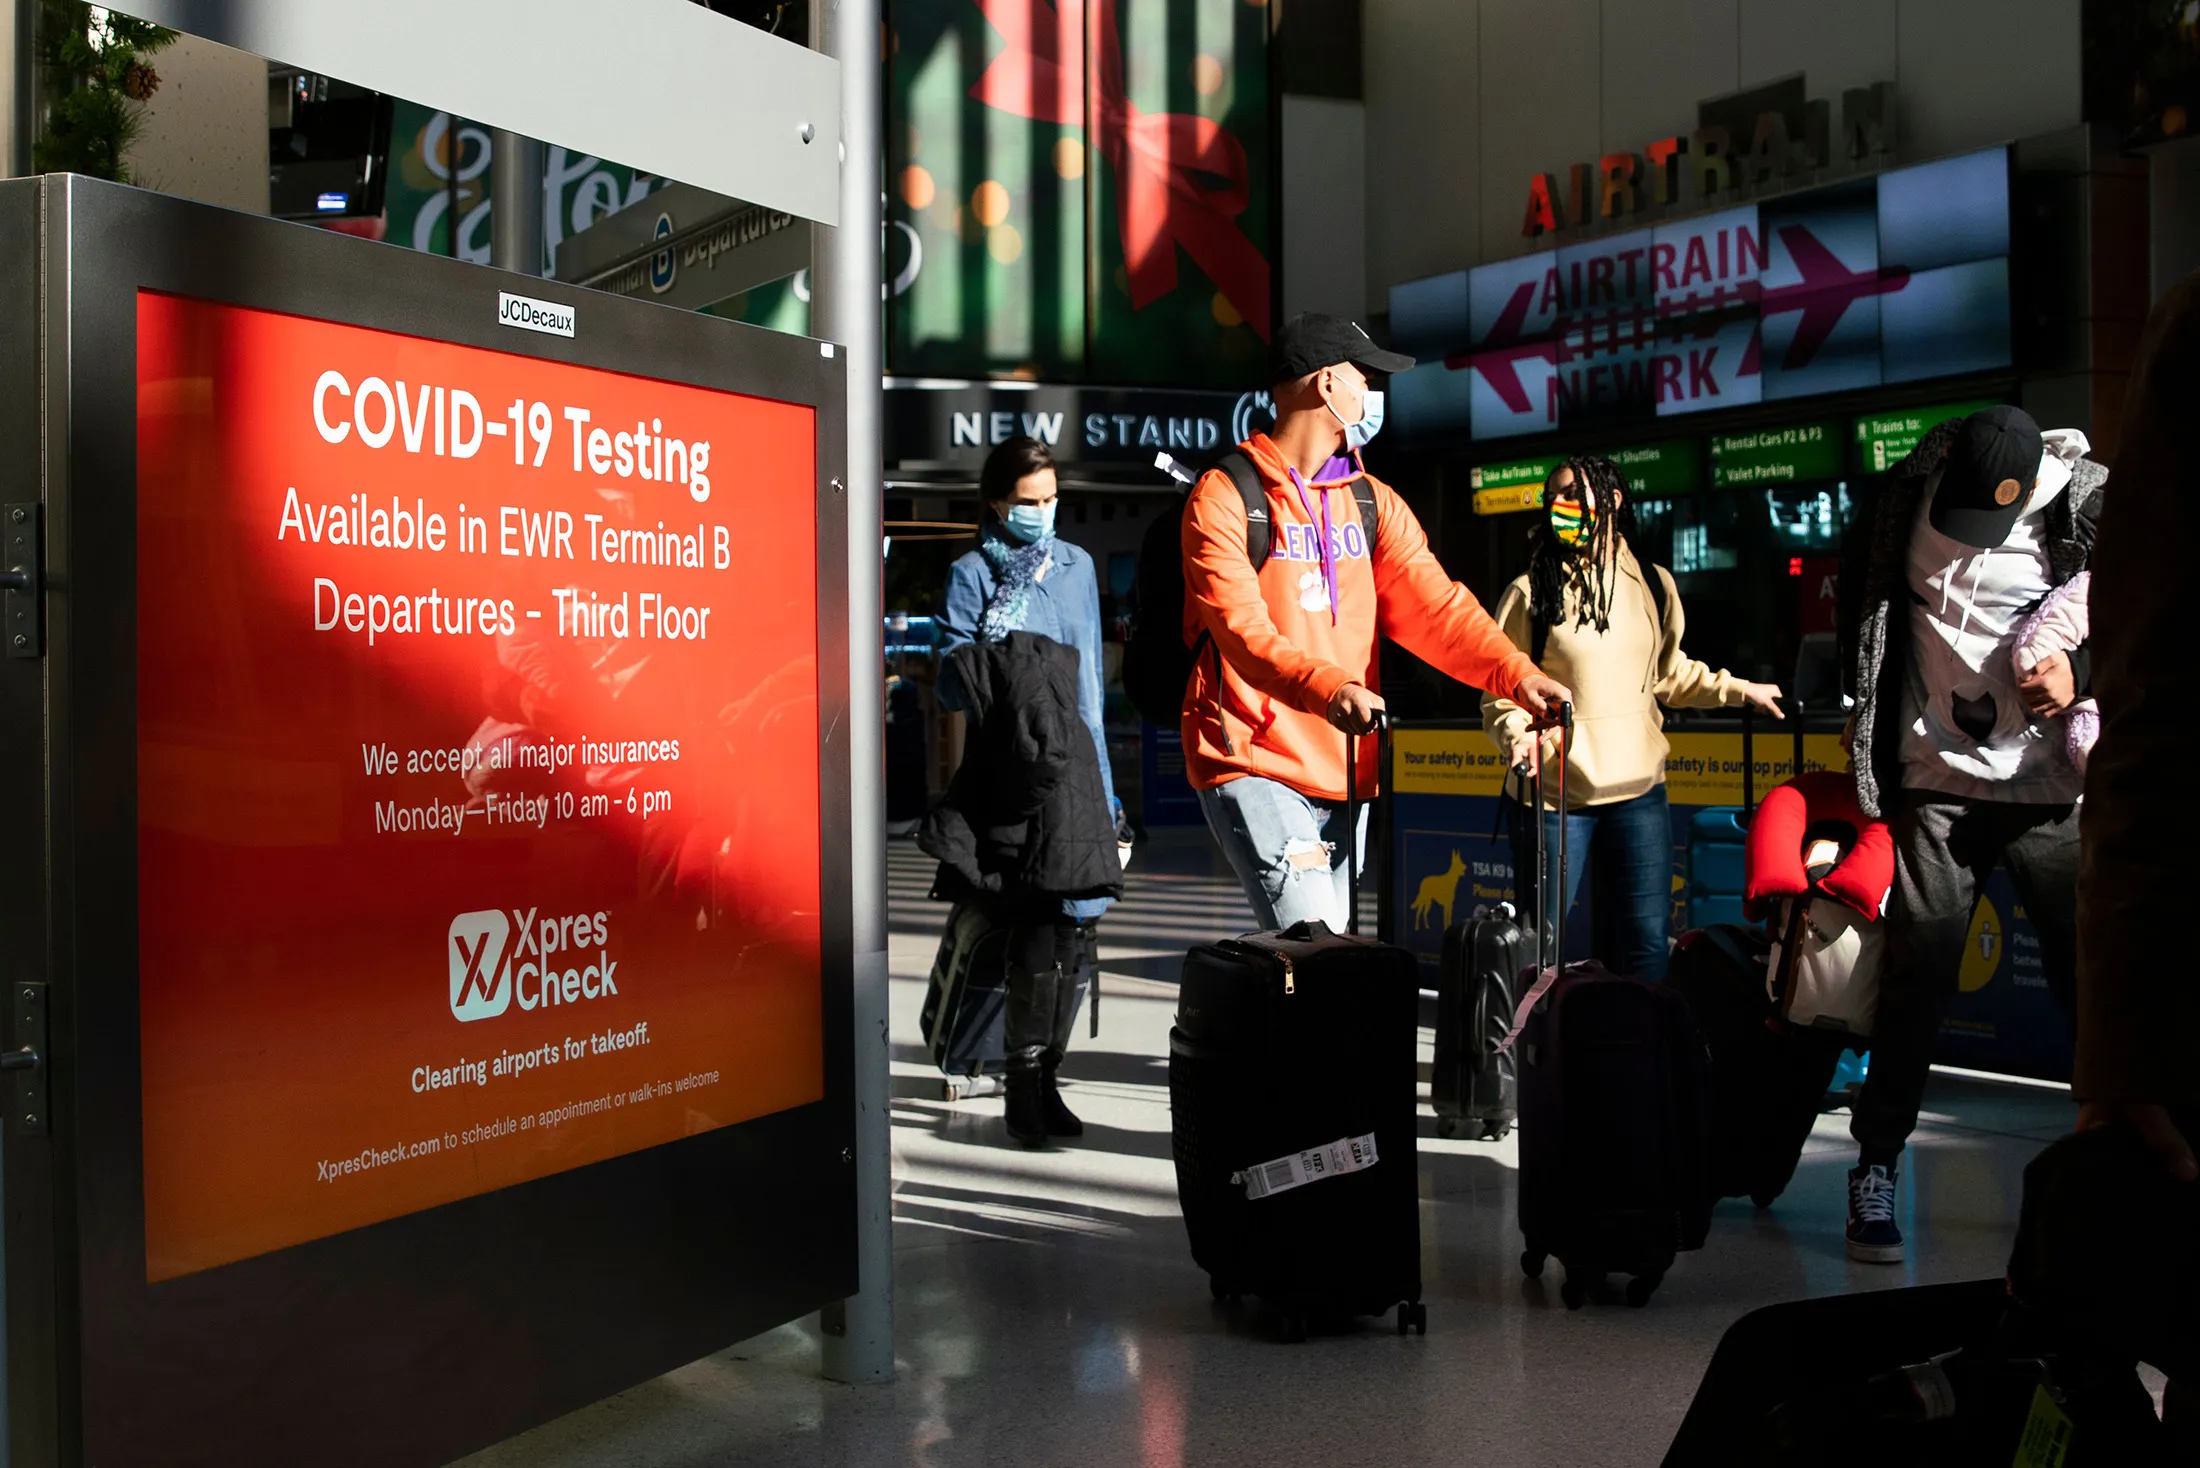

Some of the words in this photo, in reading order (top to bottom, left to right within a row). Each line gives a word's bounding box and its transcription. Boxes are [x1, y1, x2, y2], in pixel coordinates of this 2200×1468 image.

[1522, 82, 1896, 236] AIRTRAIN
[1539, 225, 1769, 315] AIRTRAIN
[501, 299, 572, 331] JCDecaux
[313, 370, 553, 467] COVID-19
[564, 407, 711, 502] Testing
[953, 411, 1064, 445] NEW
[1085, 413, 1221, 450] STAND
[1724, 434, 1757, 451] Rental
[1759, 431, 1782, 446] Cars
[1783, 429, 1797, 444] P2
[1809, 426, 1823, 441] P3
[1872, 418, 1904, 434] Trains
[1482, 468, 1500, 482] Take
[1501, 465, 1533, 481] AirTrain
[1623, 448, 1660, 464] Shuttles
[1726, 465, 1755, 482] Valet
[1755, 462, 1795, 480] Parking
[277, 487, 446, 551] Available
[459, 504, 487, 554] in
[500, 506, 574, 559] EWR
[585, 514, 705, 568] Terminal
[714, 525, 730, 570] B
[314, 577, 515, 646] Departures
[552, 588, 629, 638] Third
[640, 593, 710, 640] Floor
[362, 742, 399, 776] We
[407, 741, 483, 779] accept
[490, 738, 512, 769] all
[520, 736, 575, 775] major
[581, 735, 680, 765] insurances
[1404, 751, 1426, 764] Your
[1429, 751, 1462, 769] safety
[1466, 751, 1475, 765] is
[1478, 754, 1496, 766] our
[1665, 756, 1704, 776] safety
[1708, 756, 1719, 772] is
[1722, 760, 1744, 773] our
[555, 791, 574, 819] 10
[580, 793, 608, 817] am
[627, 787, 637, 813] 6
[643, 789, 671, 820] pm
[1472, 861, 1491, 878] TSA
[513, 907, 608, 958] Xpres
[2013, 932, 2040, 948] Pleas
[516, 950, 618, 1011] Check
[412, 1058, 487, 1093] Clearing
[492, 1043, 559, 1077] airports
[564, 1036, 587, 1061] for
[591, 1022, 650, 1055] takeoff.
[317, 1137, 440, 1184] XpresCheck.com
[444, 1132, 458, 1149] to
[462, 1115, 517, 1145] schedule
[521, 1114, 535, 1130] an
[539, 1094, 611, 1128] appointment
[614, 1092, 626, 1107] or
[629, 1080, 672, 1104] walk-ins
[675, 1070, 720, 1093] welcome
